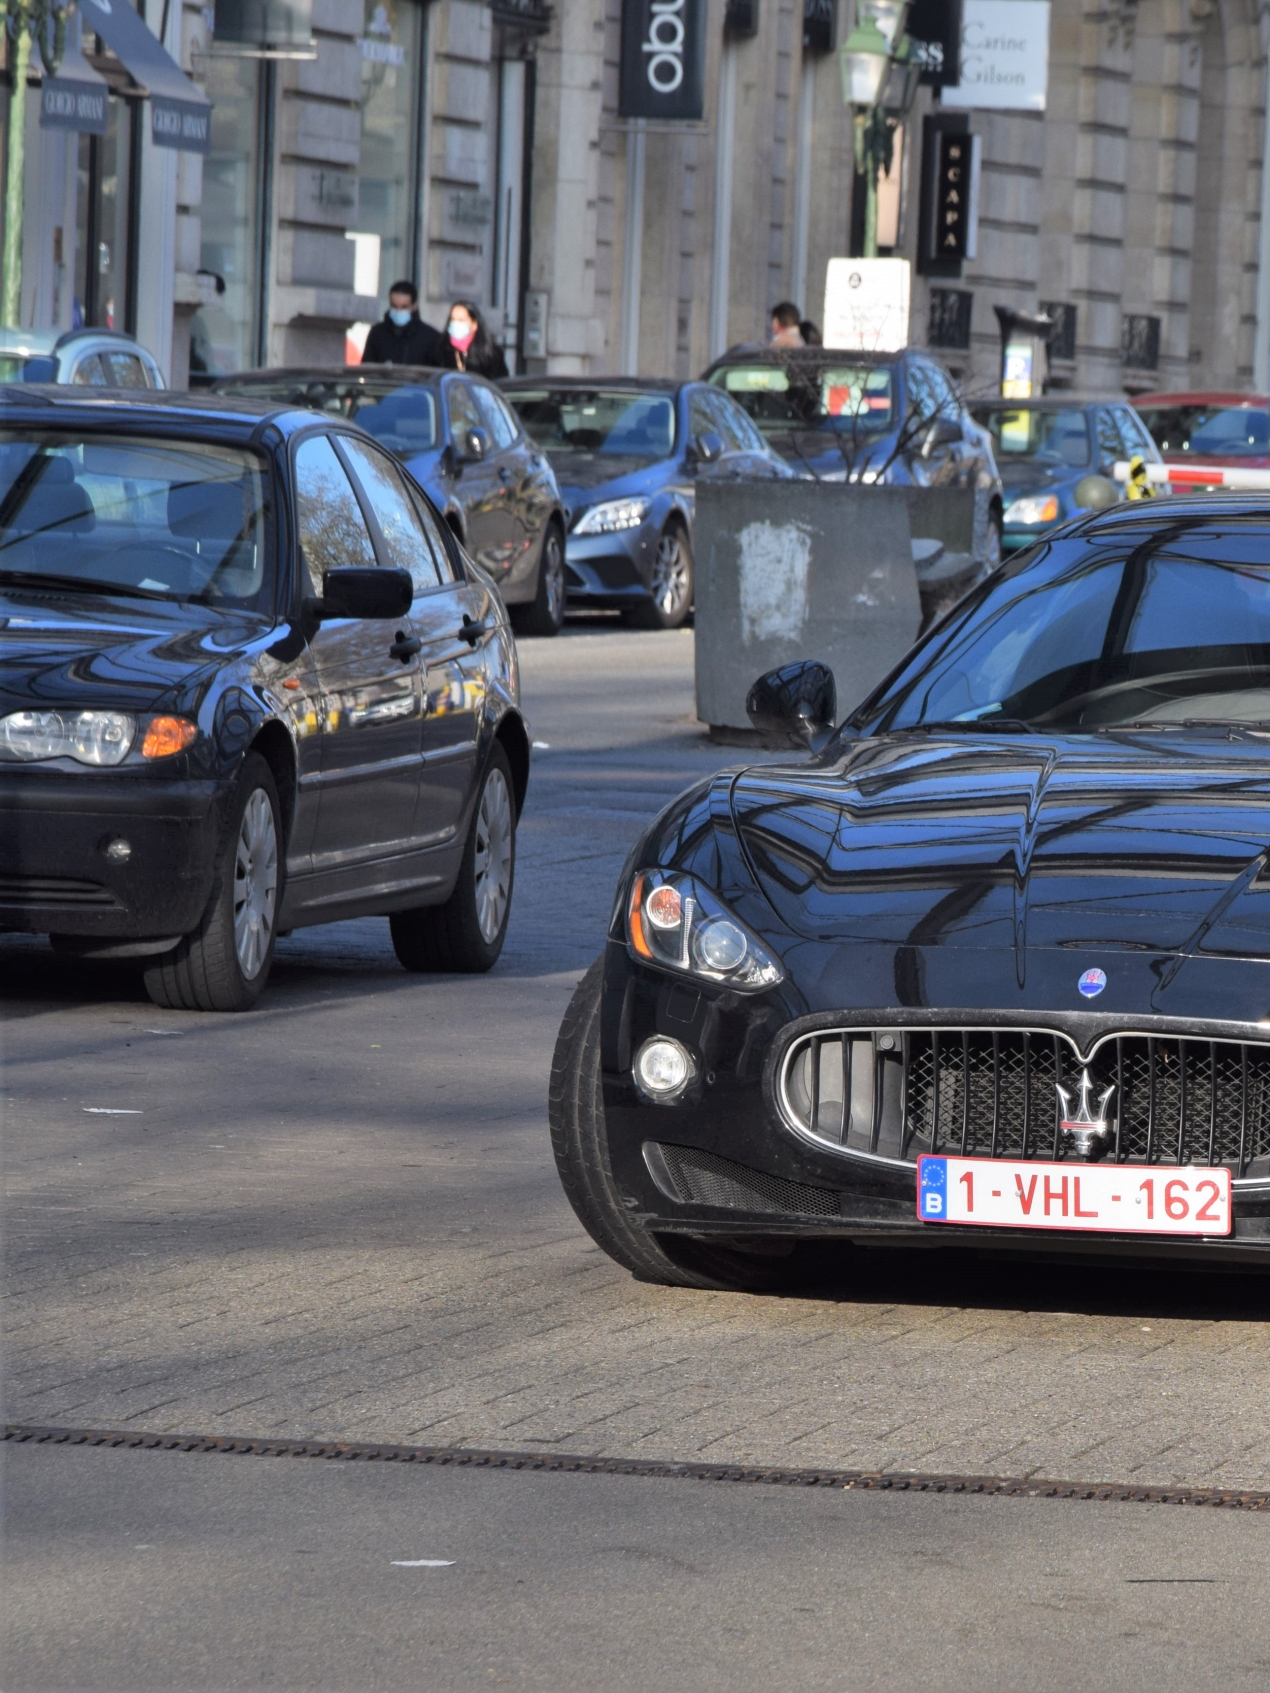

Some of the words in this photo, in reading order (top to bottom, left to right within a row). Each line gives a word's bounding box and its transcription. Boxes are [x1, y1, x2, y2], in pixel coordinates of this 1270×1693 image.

[962, 20, 1027, 52] Carine
[961, 55, 1026, 85] Gilson
[944, 144, 962, 248] SCAPA
[925, 1193, 942, 1213] B
